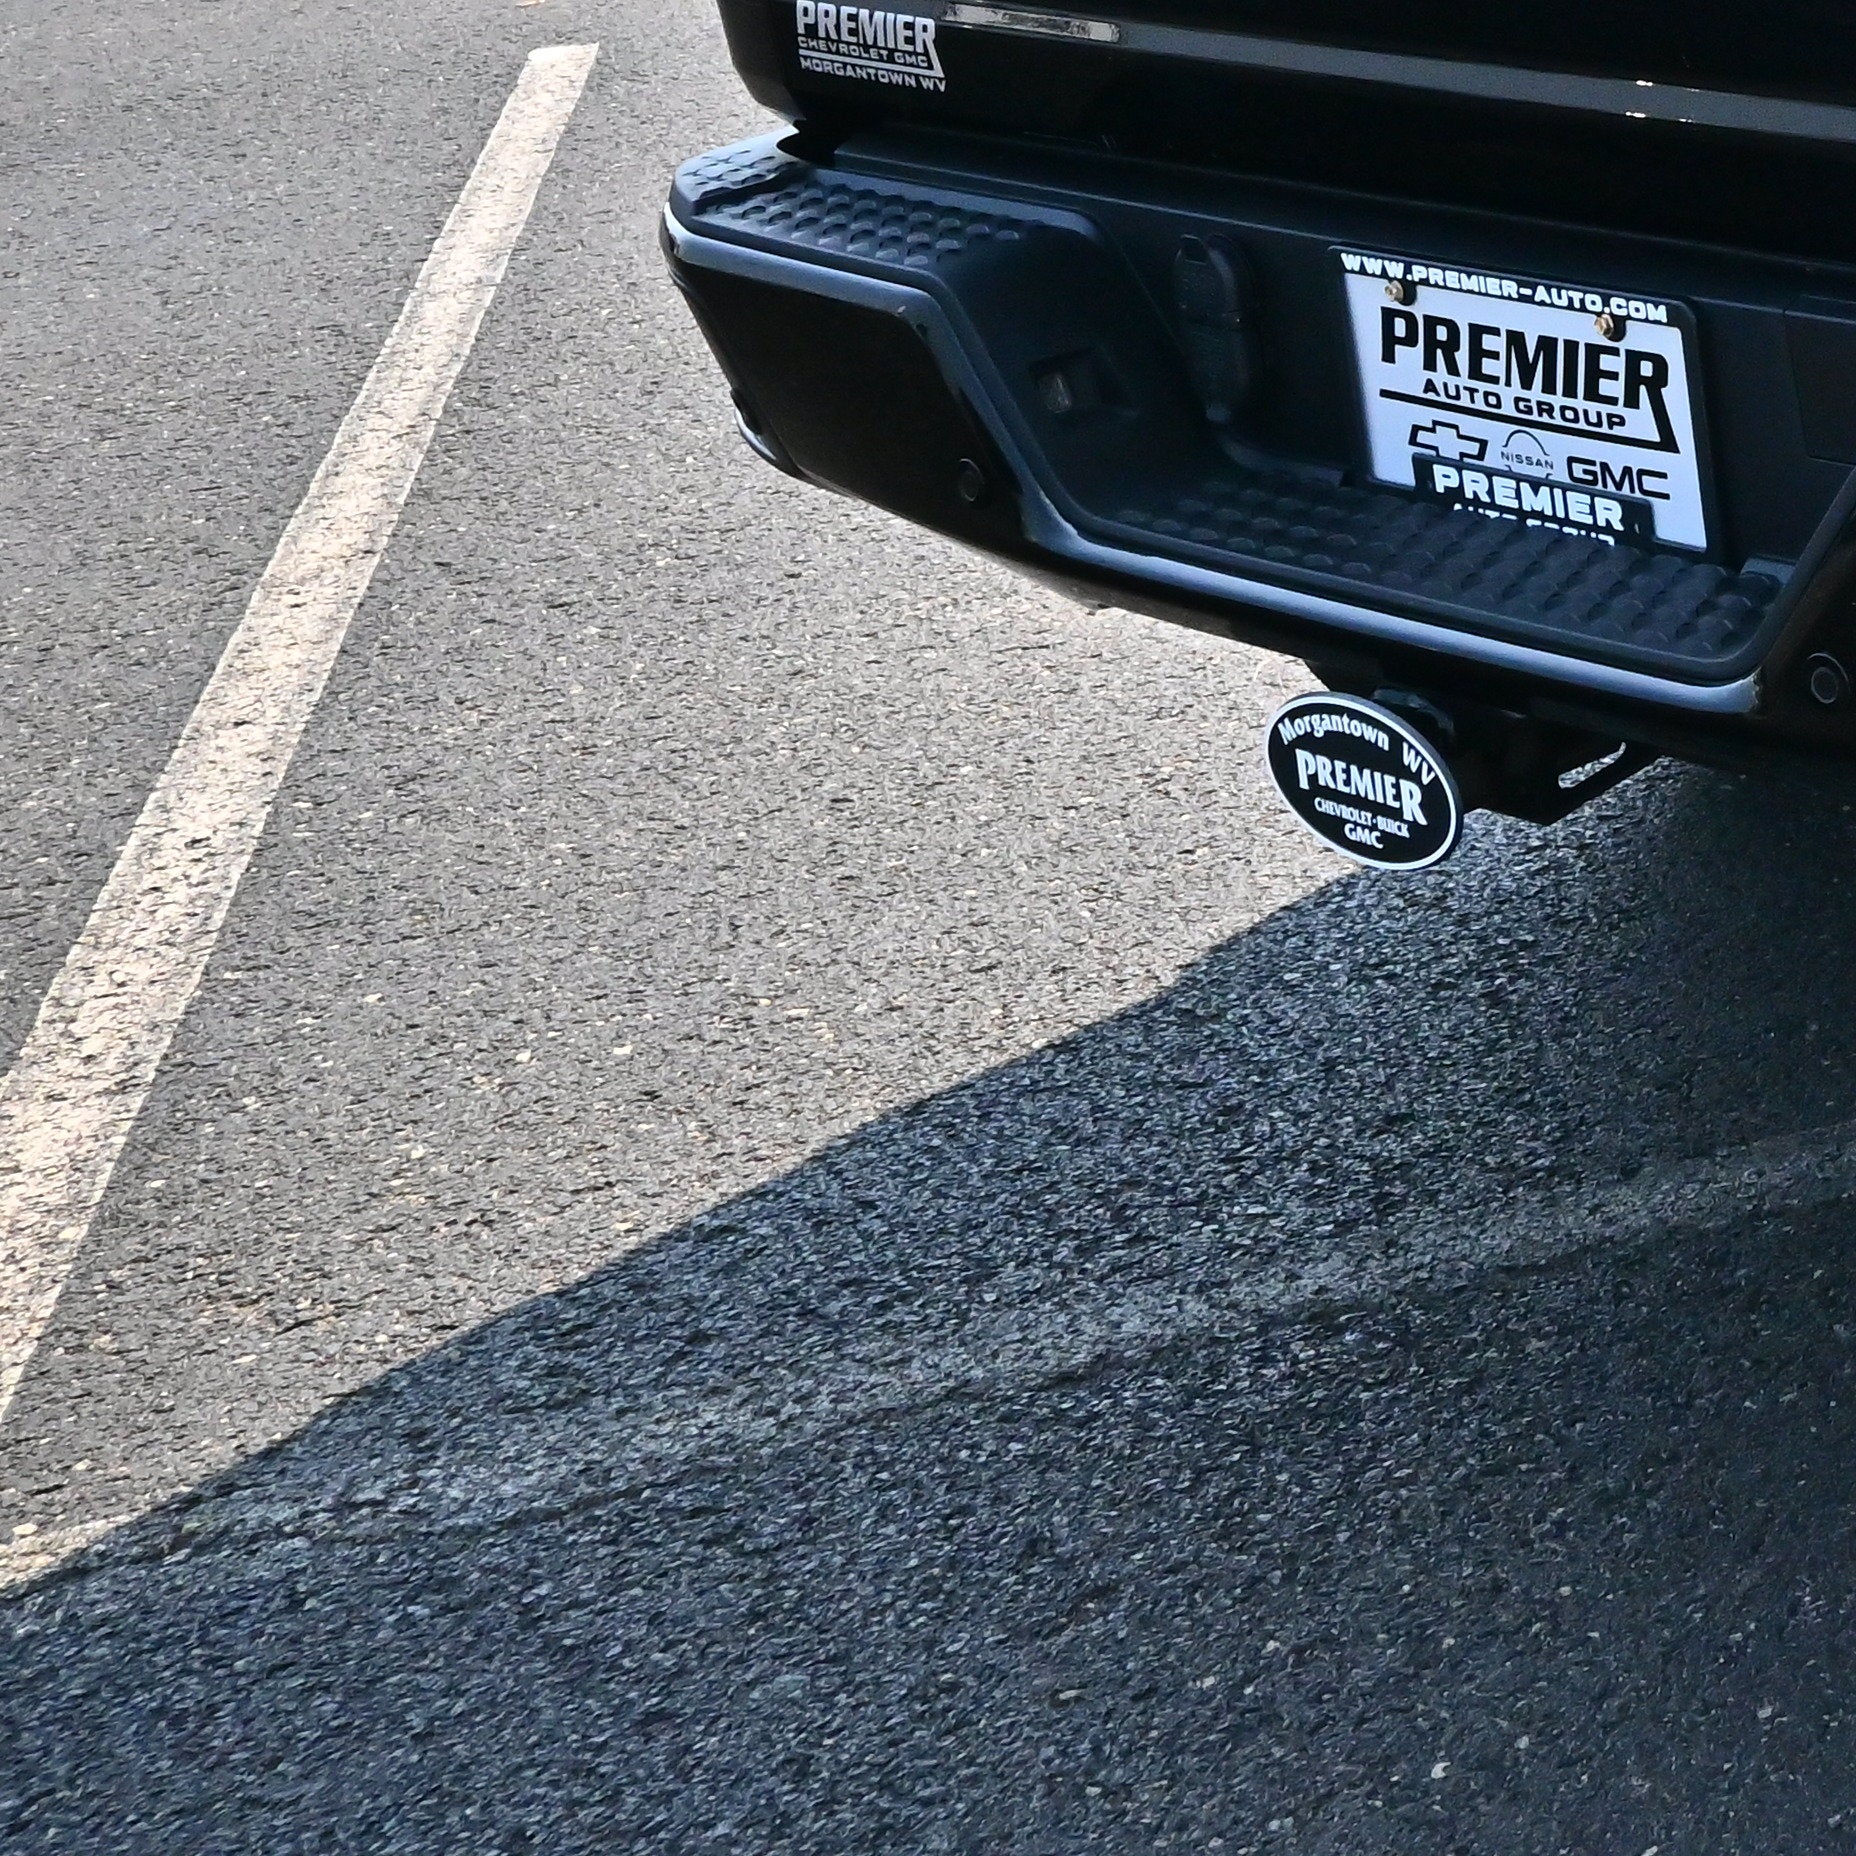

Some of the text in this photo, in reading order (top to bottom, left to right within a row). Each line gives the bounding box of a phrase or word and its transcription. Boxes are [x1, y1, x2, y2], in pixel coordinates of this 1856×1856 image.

[797, 35, 930, 67] CHEVROLET GMC
[799, 56, 946, 93] MORGANTOWN WV
[1340, 252, 1668, 324] WWW.PREMIER-AUTO.COM
[1379, 305, 1672, 429] PREMIER
[1422, 378, 1627, 431] AUTO GROUP
[1431, 462, 1625, 532] PREMIER
[1500, 450, 1671, 501] NISSAN GMC
[1277, 712, 1436, 786] Morgantown WV
[1294, 748, 1429, 826] PREMIER
[1343, 823, 1384, 850] GMC
